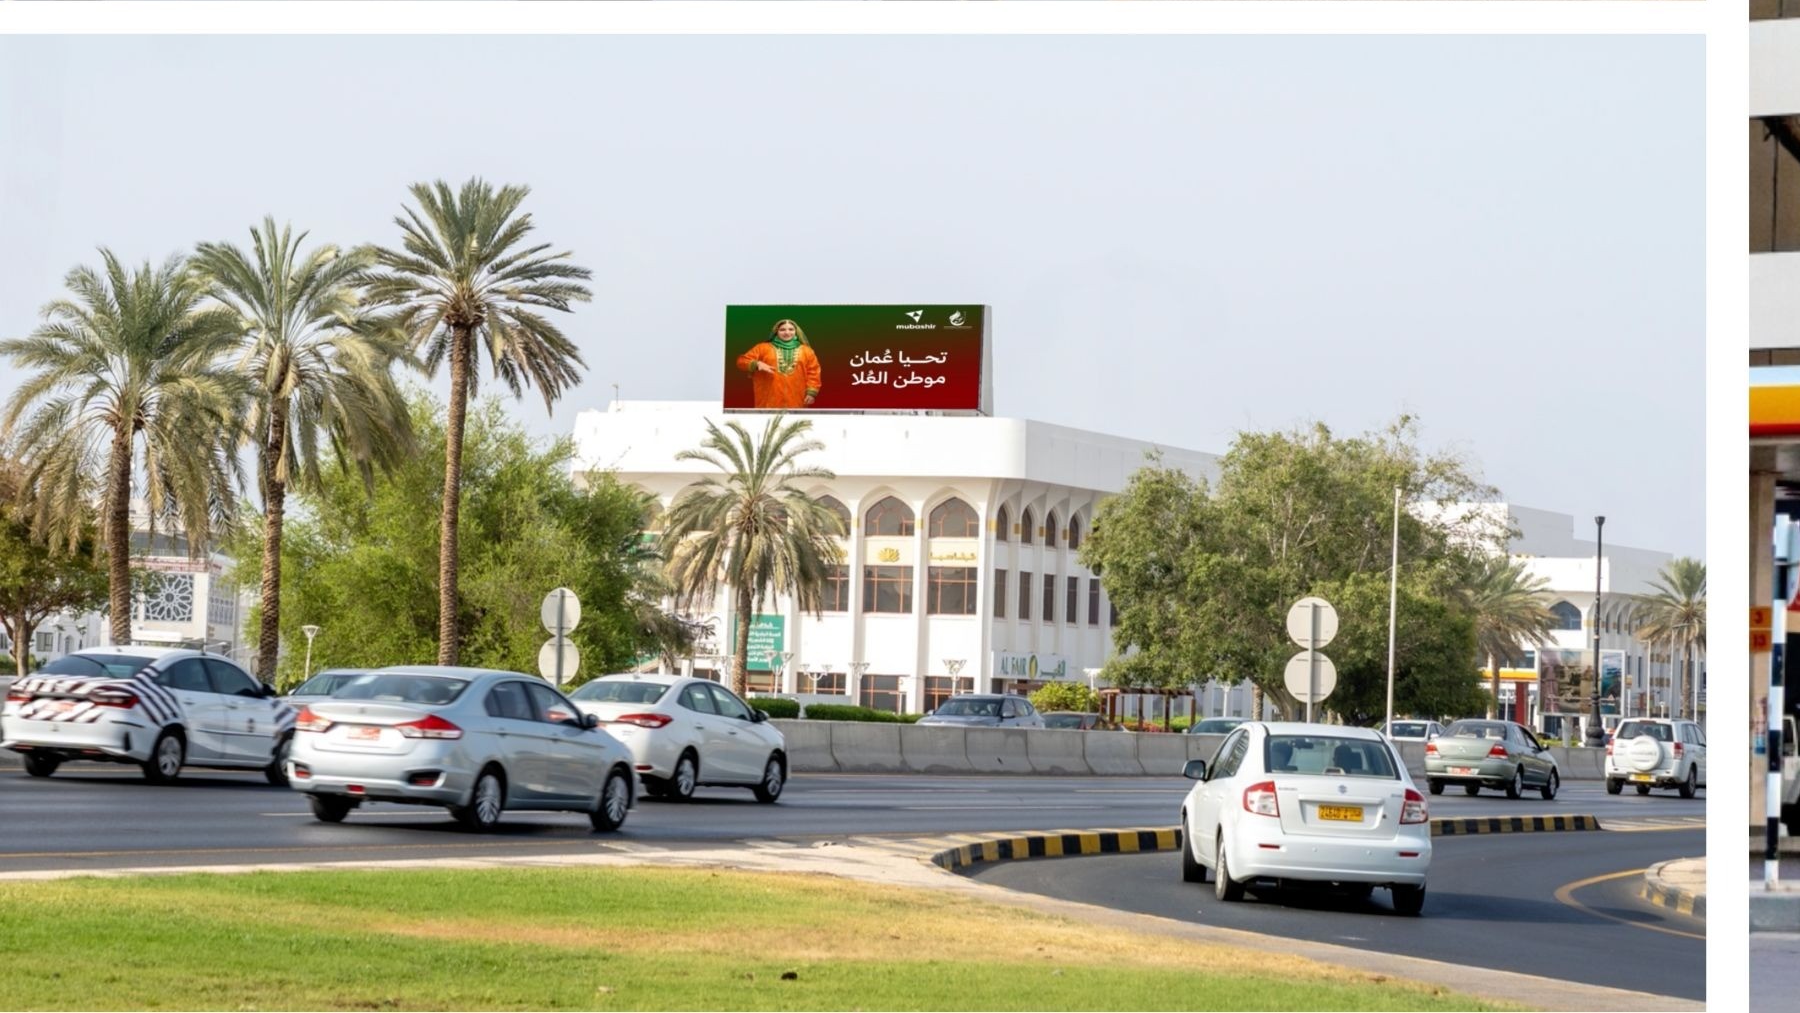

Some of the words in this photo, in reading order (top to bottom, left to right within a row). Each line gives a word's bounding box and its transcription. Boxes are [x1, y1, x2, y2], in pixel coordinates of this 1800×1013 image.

[898, 350, 948, 367] تحيا
[893, 371, 945, 388] موطن
[1011, 656, 1026, 676] FAIR
